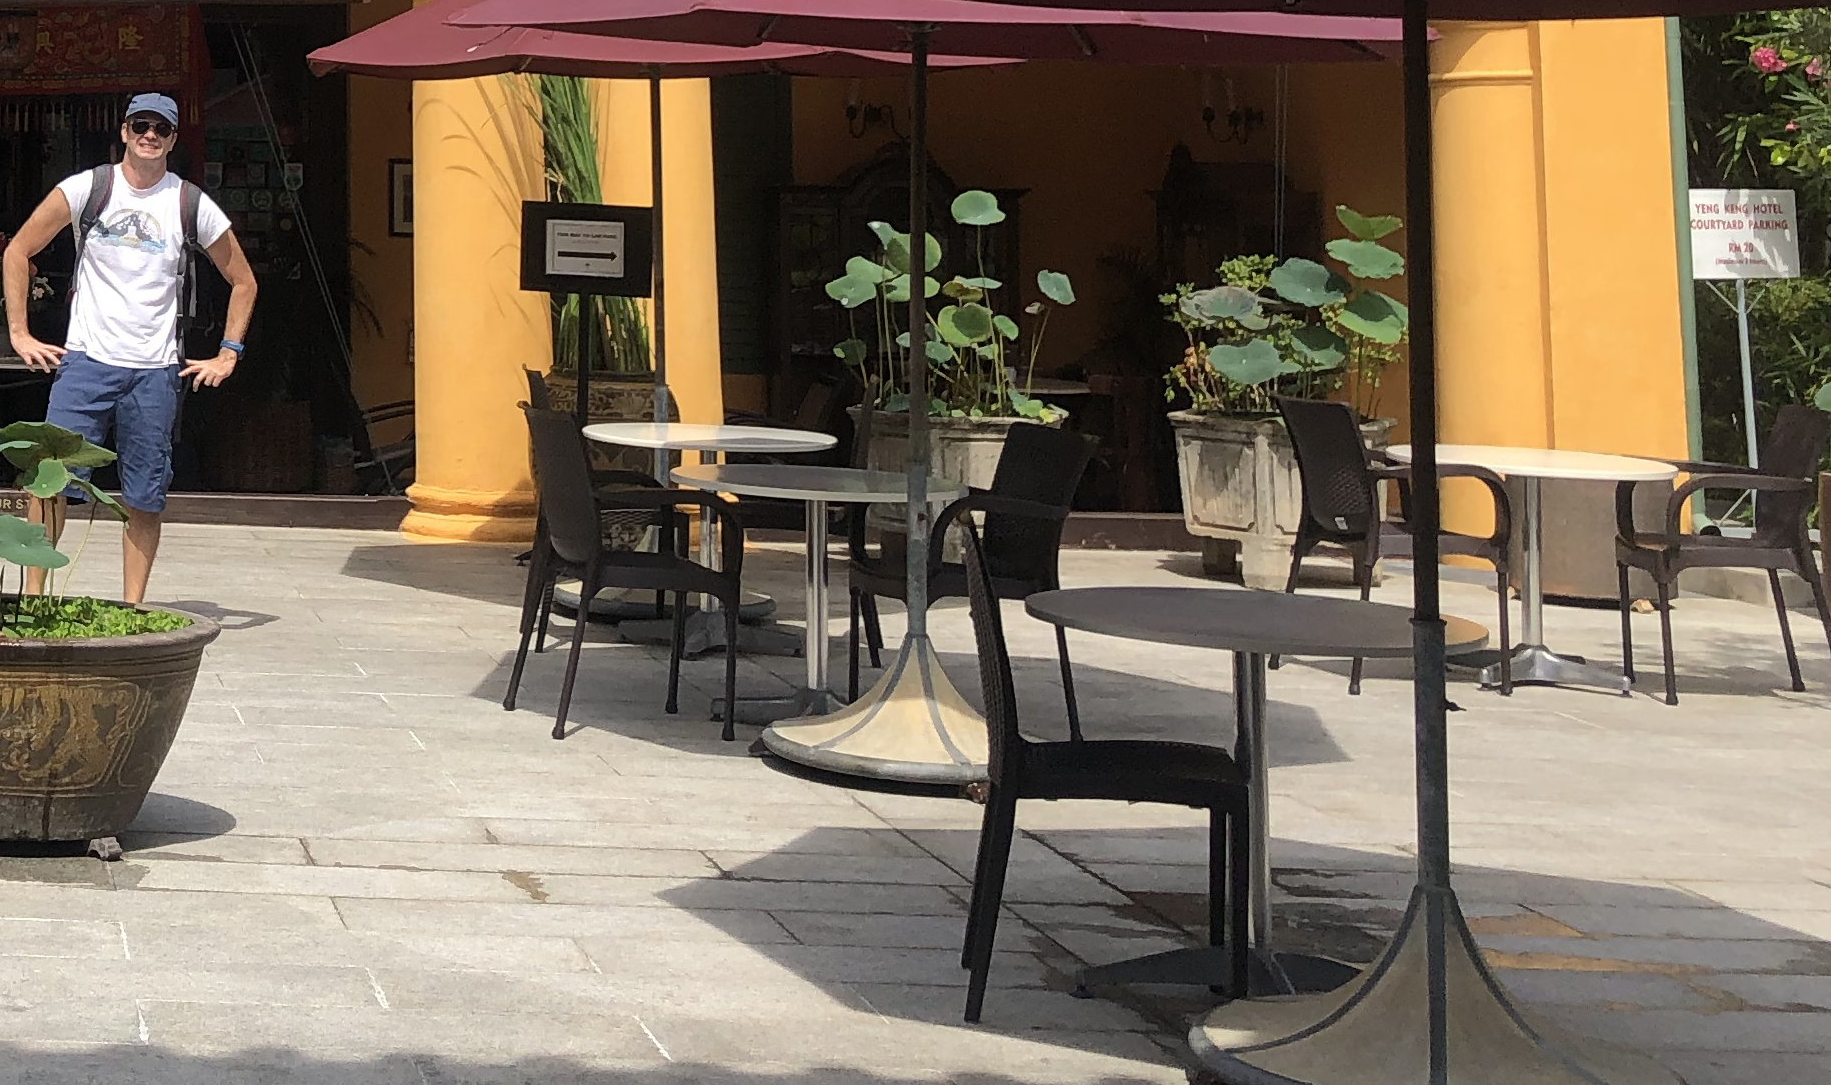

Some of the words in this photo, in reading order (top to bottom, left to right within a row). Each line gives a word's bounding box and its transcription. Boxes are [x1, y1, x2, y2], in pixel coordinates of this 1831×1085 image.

[1695, 204, 1720, 214] YENG
[1724, 204, 1749, 214] KENG
[1753, 204, 1783, 214] HOTEL
[1690, 219, 1744, 230] COURTYARD
[1749, 219, 1788, 230] PARKING
